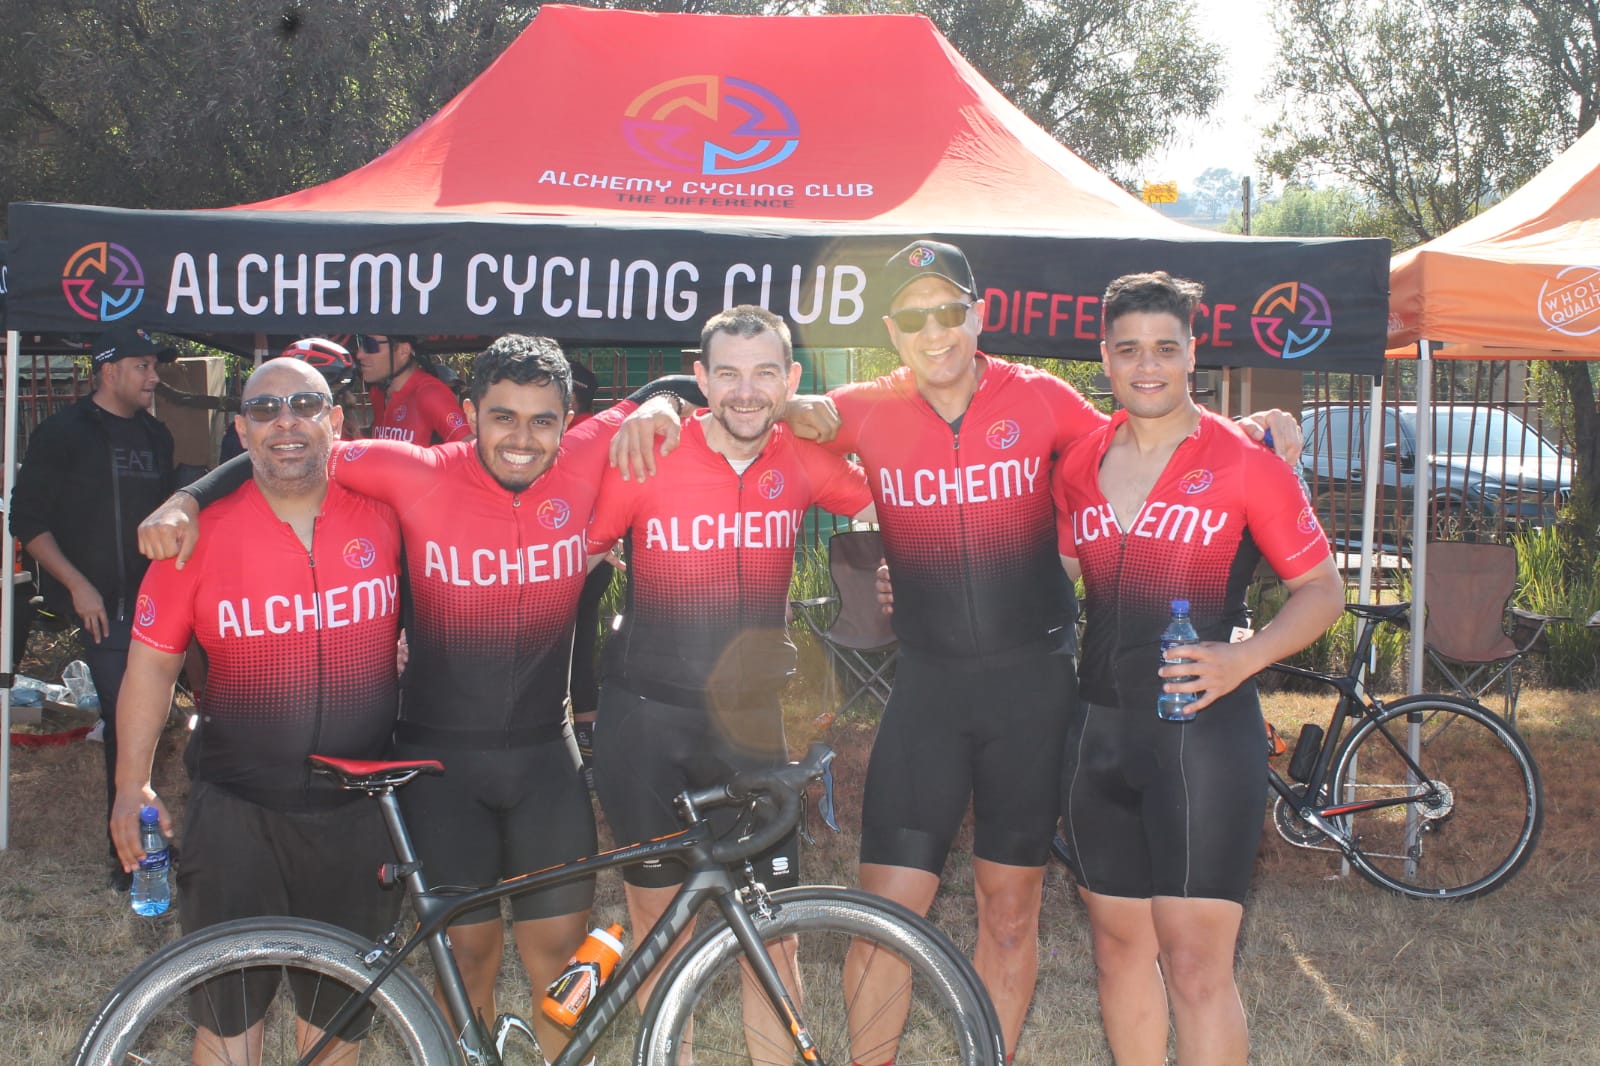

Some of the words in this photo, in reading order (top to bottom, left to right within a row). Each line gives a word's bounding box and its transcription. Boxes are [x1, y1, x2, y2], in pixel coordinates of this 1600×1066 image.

[538, 169, 672, 193] ALCHEMY
[682, 181, 794, 197] CYCLING
[805, 183, 874, 197] CLUB
[616, 193, 657, 203] THE
[664, 195, 795, 208] DIFFERENCE
[166, 252, 442, 316] ALCHEMY
[466, 252, 700, 322] CYCLING
[723, 263, 866, 325] CLUB
[1544, 277, 1600, 311] WHOL
[983, 287, 1237, 348] DIFFECE
[880, 456, 1040, 507] ALCHEMY
[645, 509, 803, 552] ALCHEMY
[217, 573, 398, 638] ALCHEMY
